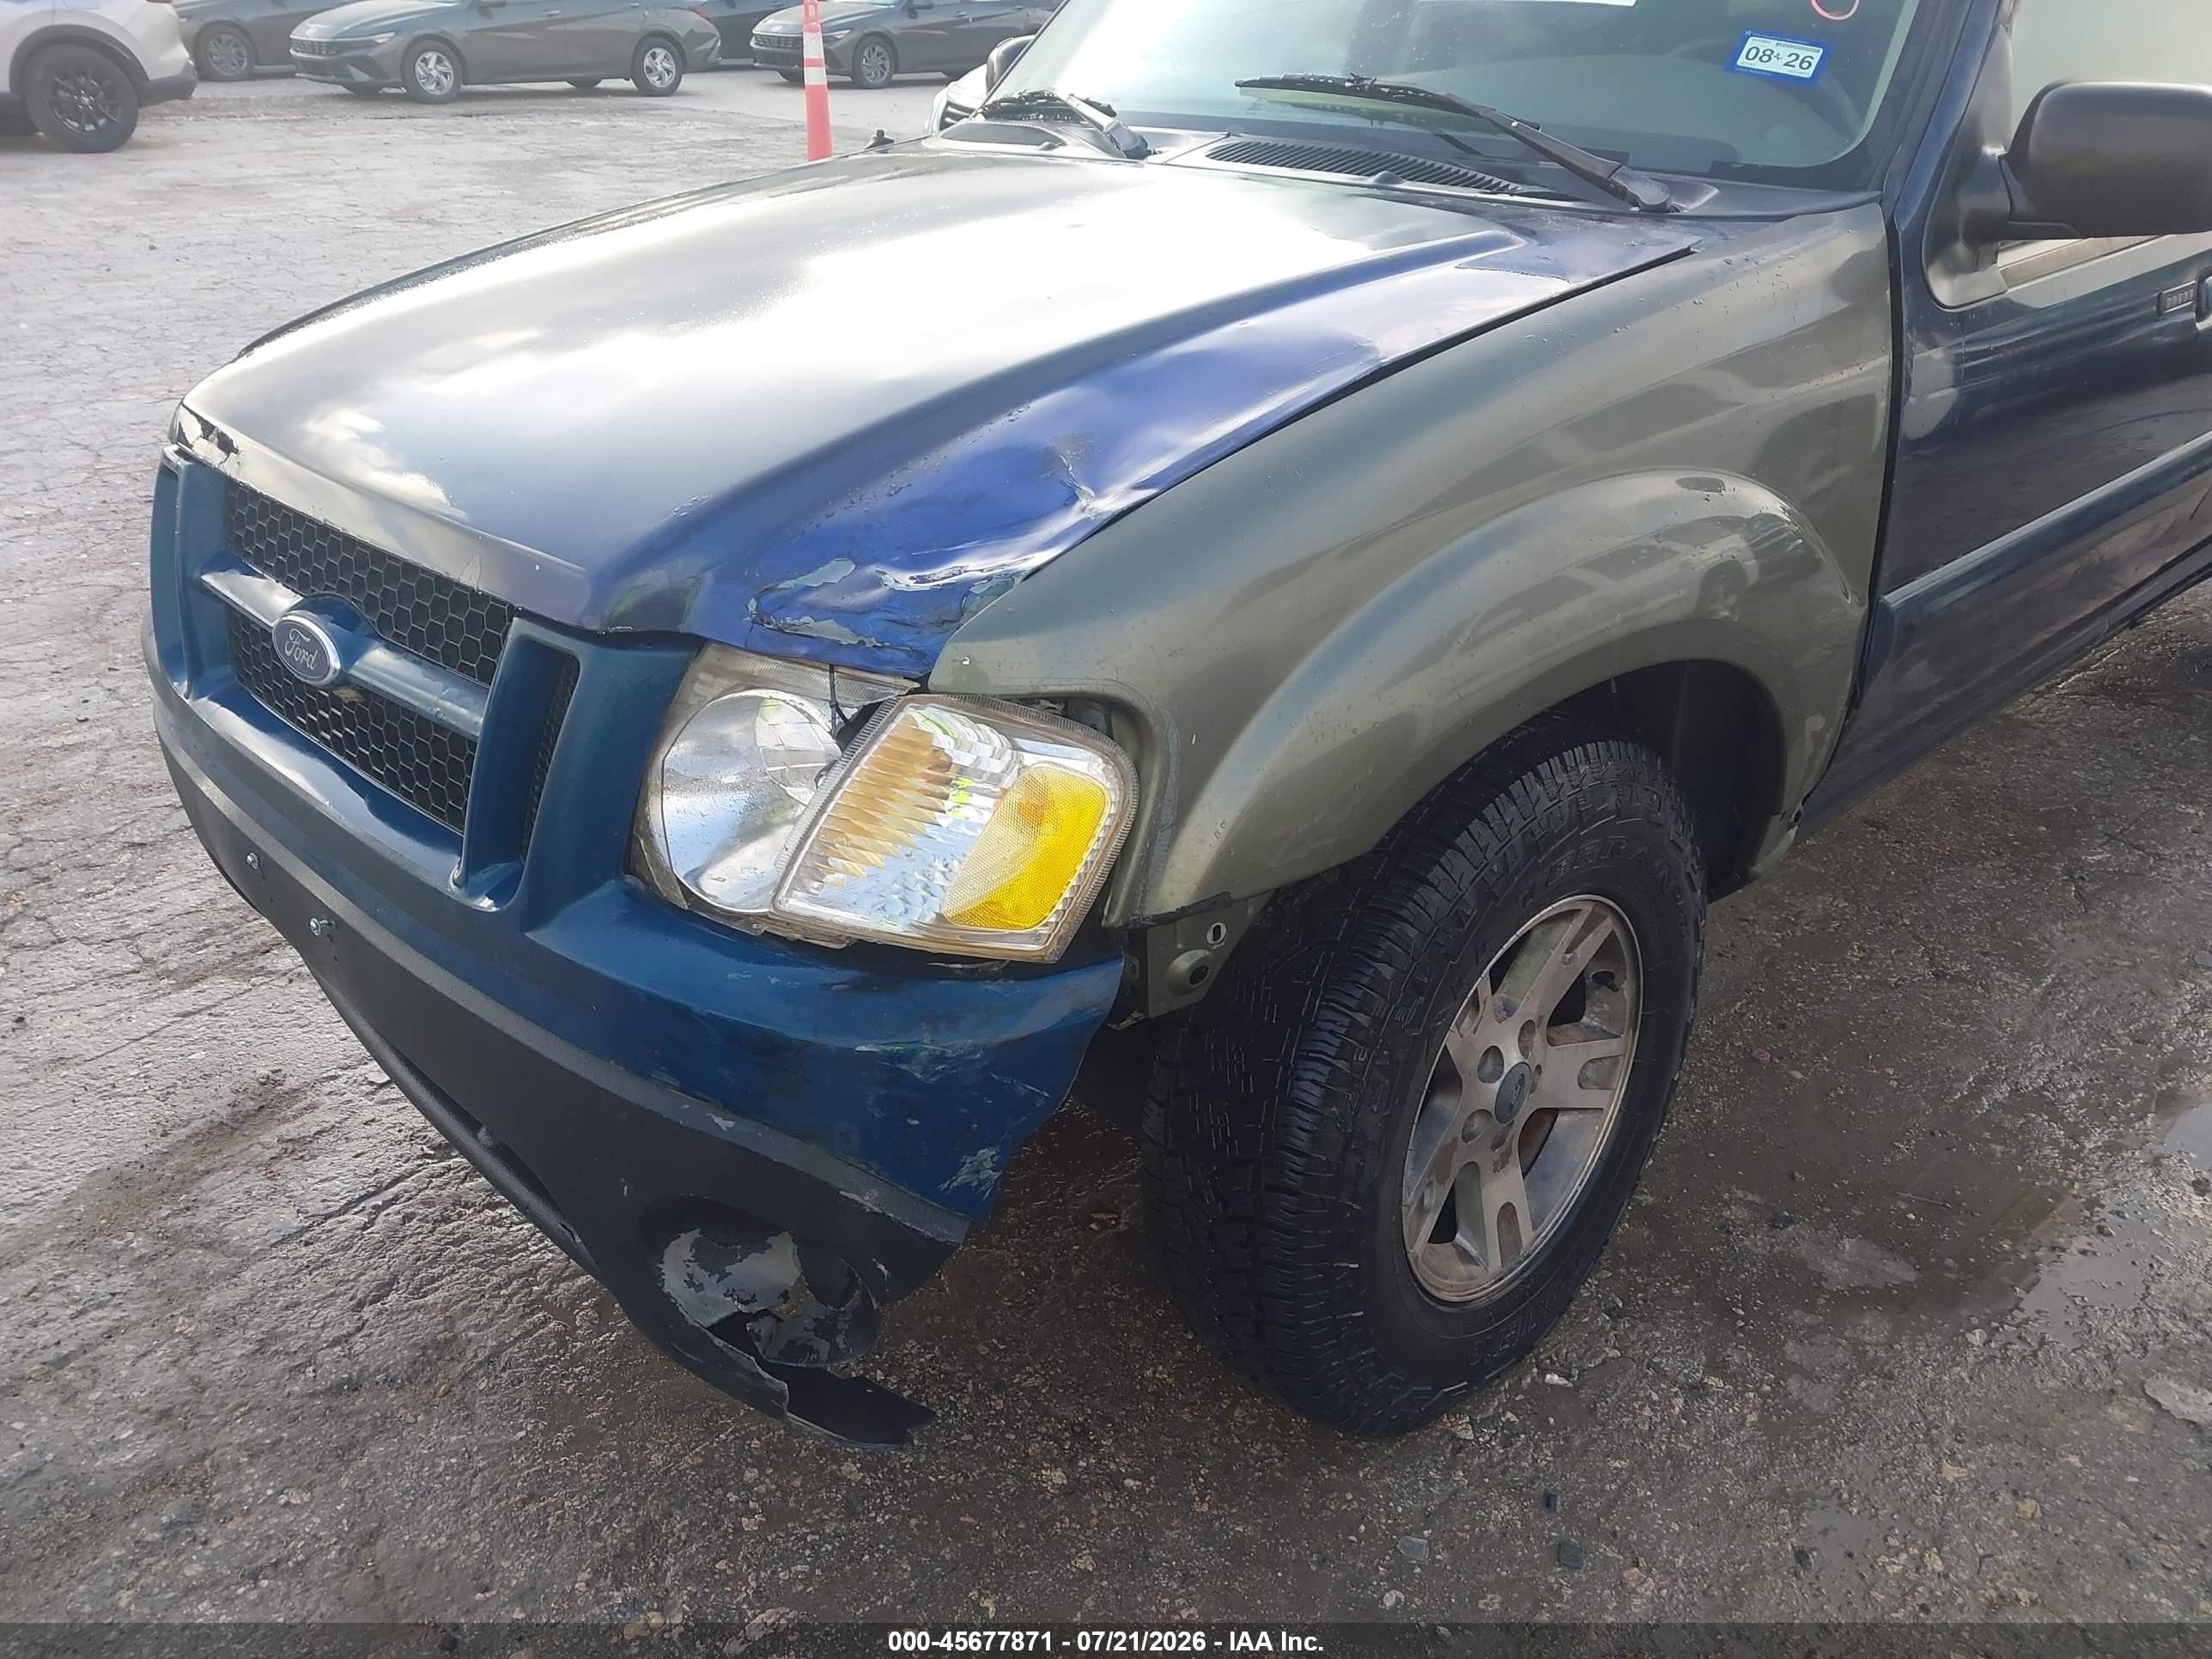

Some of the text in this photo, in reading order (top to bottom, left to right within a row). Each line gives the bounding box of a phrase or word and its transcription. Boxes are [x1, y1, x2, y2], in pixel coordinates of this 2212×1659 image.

[1745, 46, 1814, 70] 08 26
[285, 628, 318, 670] Ford
